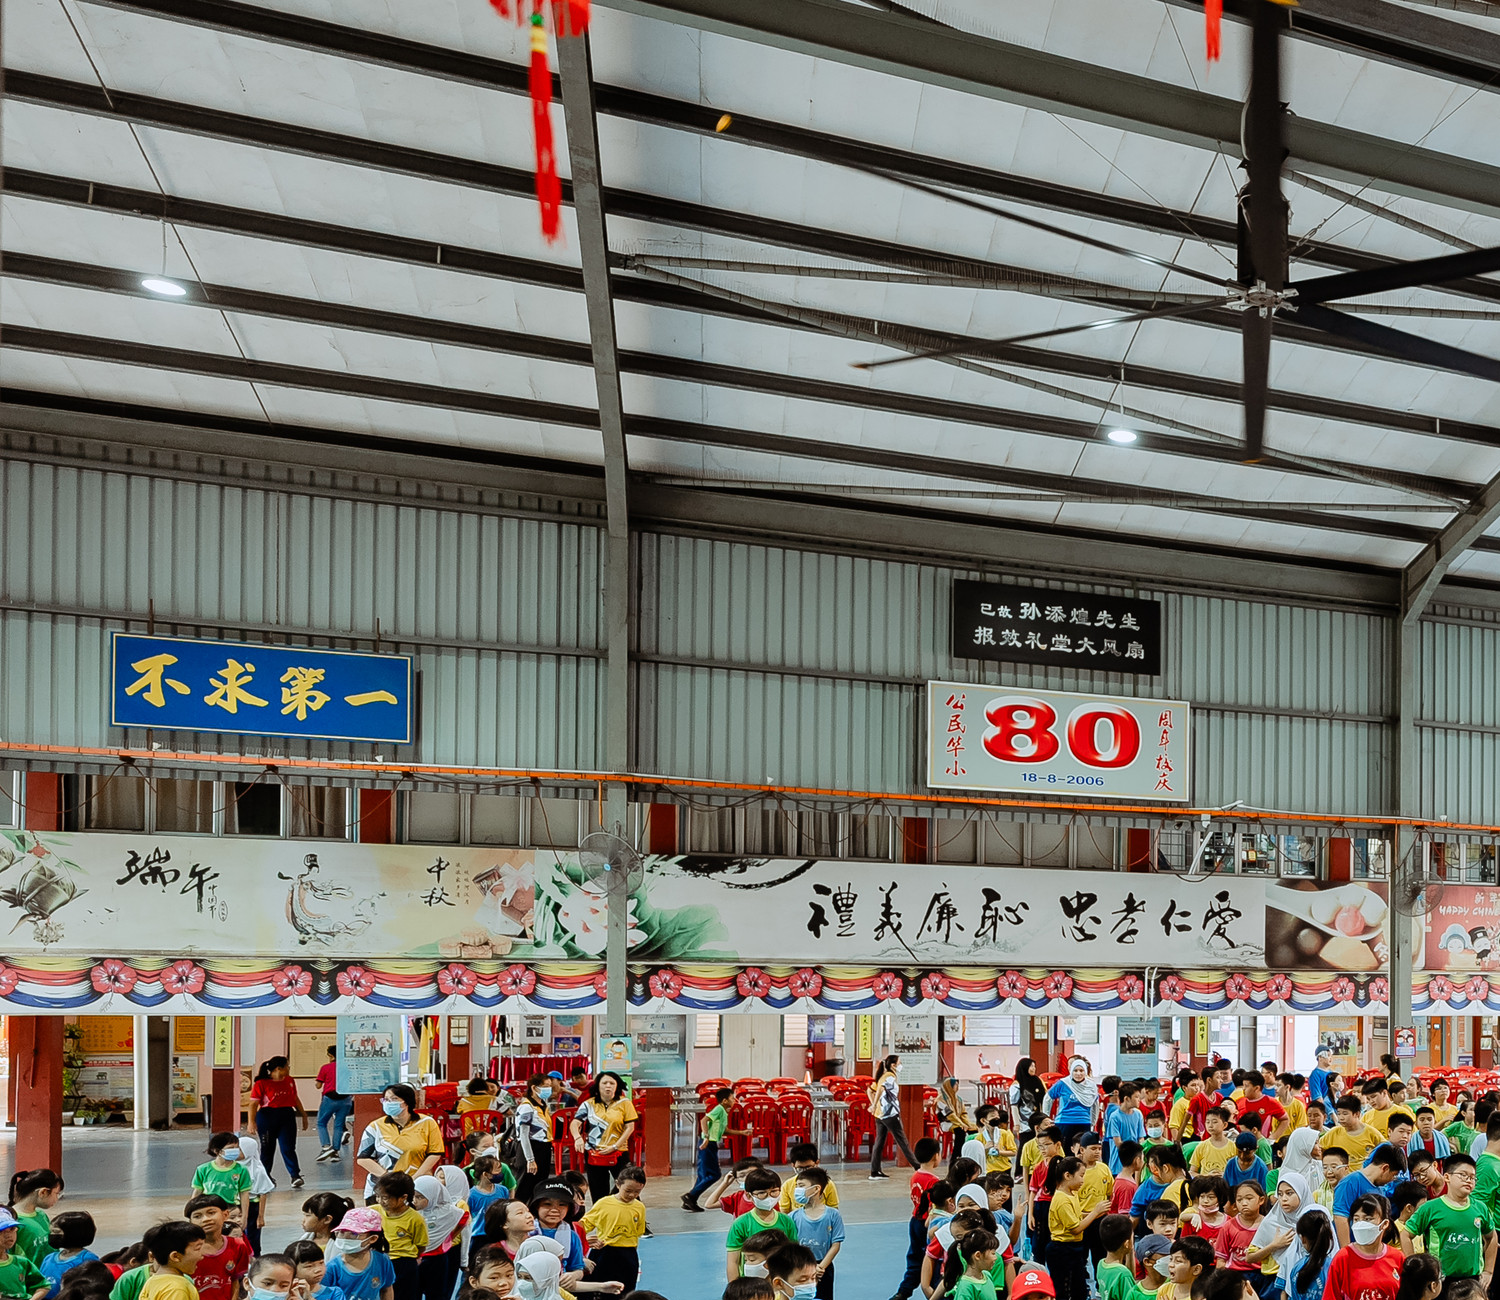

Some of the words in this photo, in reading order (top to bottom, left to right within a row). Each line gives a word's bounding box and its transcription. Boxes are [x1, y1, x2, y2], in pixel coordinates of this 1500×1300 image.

[973, 626, 1145, 660] 报效礼堂大风扇
[124, 652, 399, 722] 不求第一
[945, 692, 967, 776] 公民华小
[981, 695, 1142, 770] 80
[1153, 709, 1174, 792] 周年校庆
[1020, 772, 1105, 787] 18-8-2006
[116, 847, 220, 913] 端午
[420, 856, 456, 907] 中秋
[1439, 905, 1469, 916] HAPPY
